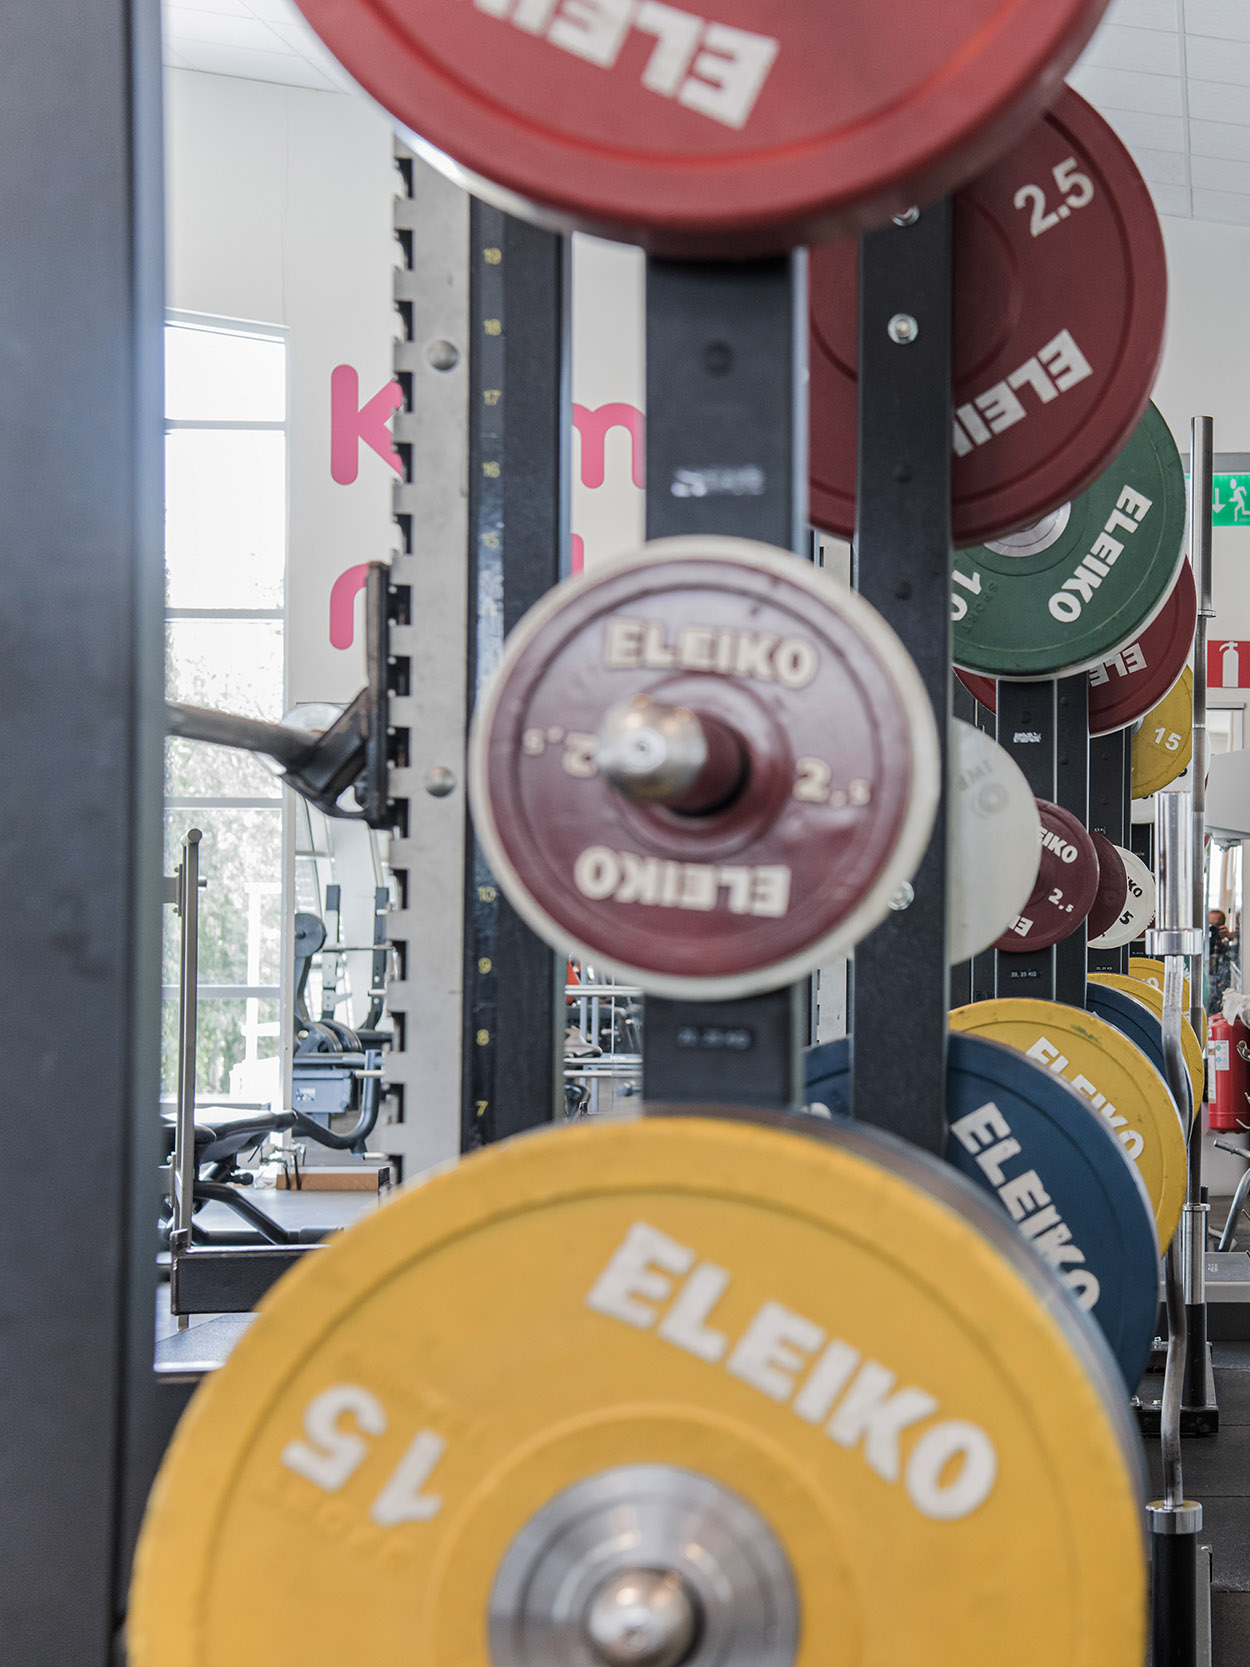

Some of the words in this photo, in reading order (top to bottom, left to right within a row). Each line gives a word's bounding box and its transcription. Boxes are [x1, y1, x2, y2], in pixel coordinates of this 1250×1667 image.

[455, 0, 779, 130] ELE
[1012, 156, 1095, 239] 2.5
[483, 389, 502, 406] 17
[953, 328, 1094, 458] ELEI
[1048, 484, 1153, 623] ELEIKO
[604, 618, 820, 690] ELEIKO
[1090, 642, 1148, 687] ELE
[1154, 727, 1182, 751] 15
[793, 758, 873, 807] 2.5
[1039, 827, 1078, 863] EIKO
[574, 846, 794, 918] ELEIKO
[1048, 888, 1074, 913] 2.5
[1119, 910, 1134, 925] 5
[478, 957, 492, 974] 9
[476, 1029, 490, 1046] 8
[475, 1100, 489, 1117] 7
[951, 1101, 1101, 1311] ELEIKO
[586, 1220, 998, 1521] ELEIKO
[281, 1382, 448, 1528] 15
